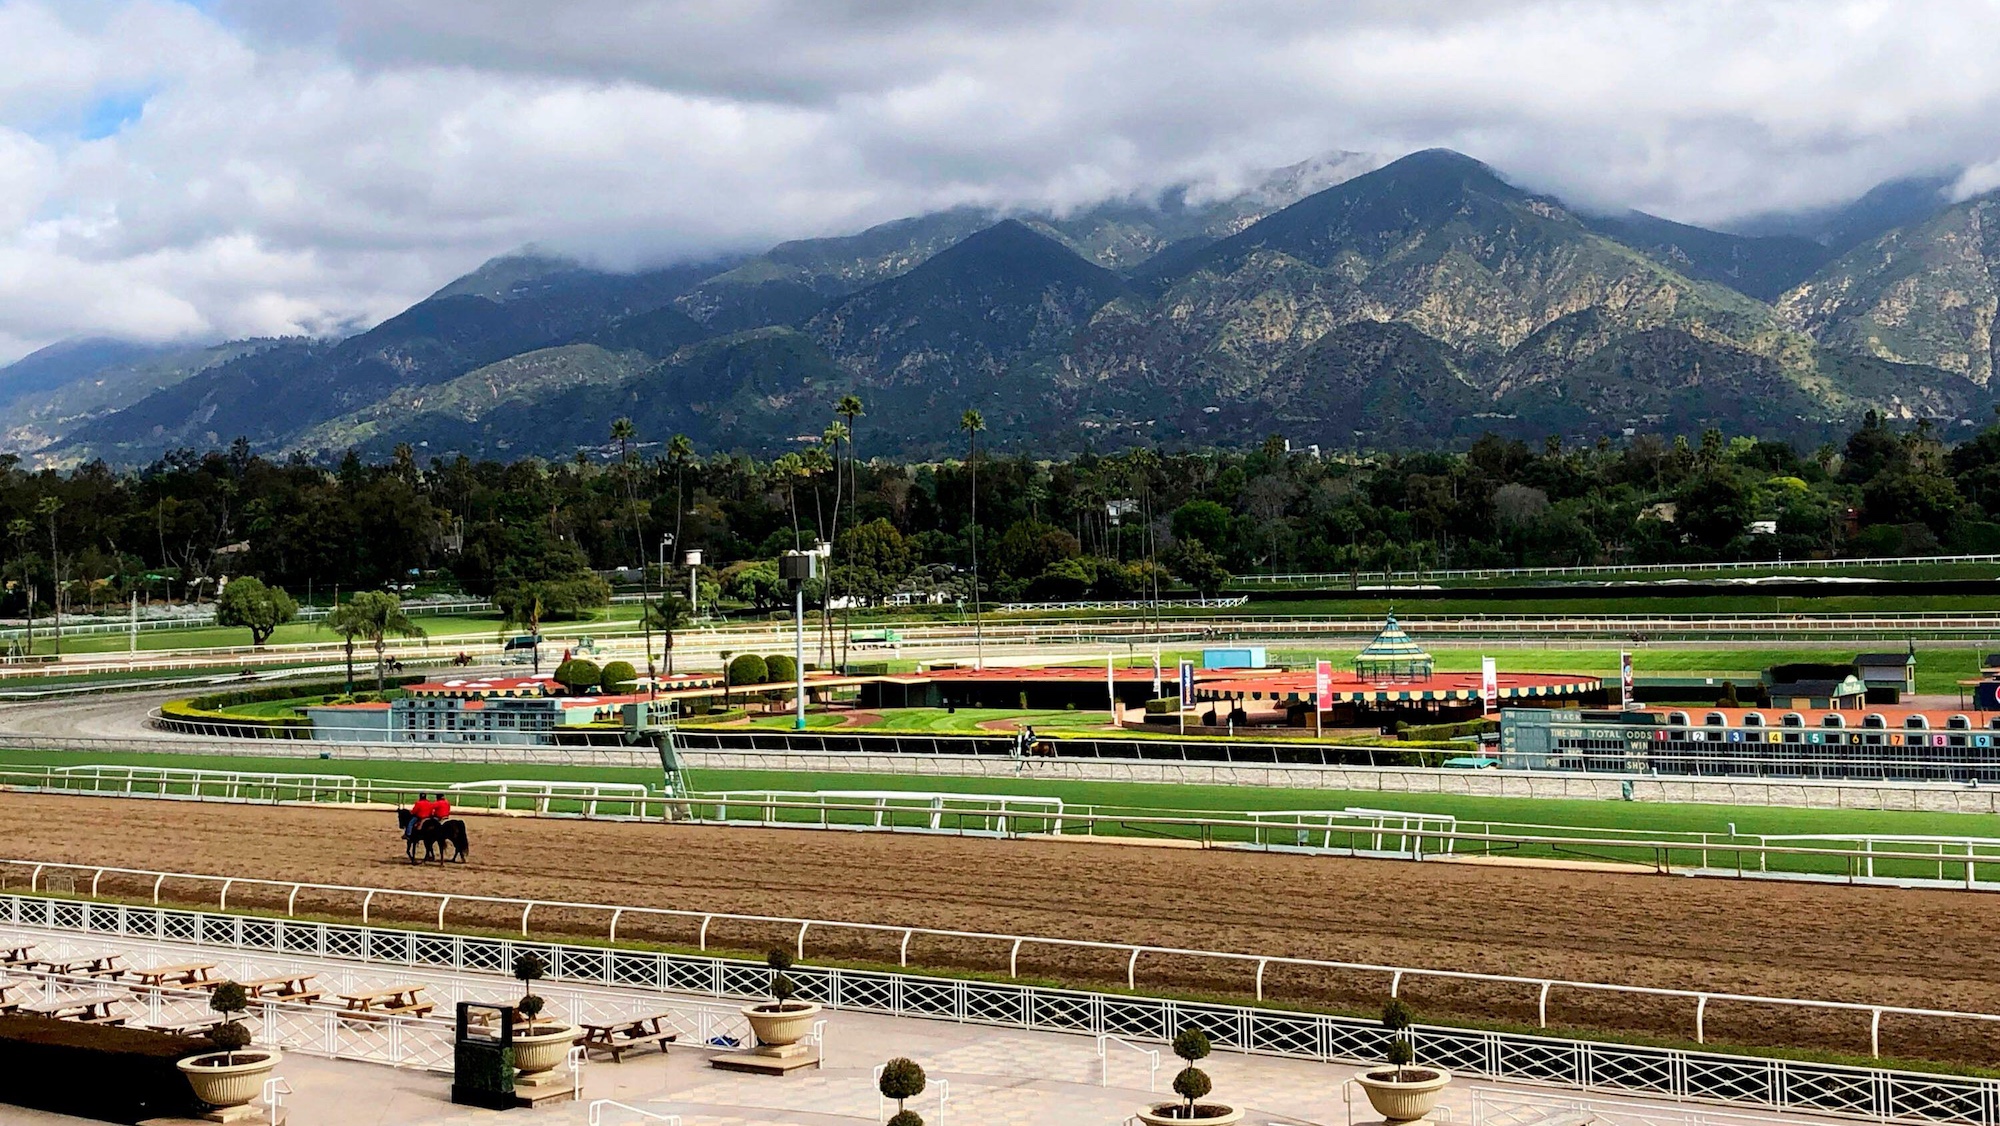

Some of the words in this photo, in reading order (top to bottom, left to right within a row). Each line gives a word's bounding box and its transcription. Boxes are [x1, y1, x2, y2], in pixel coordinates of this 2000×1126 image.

[1551, 713, 1581, 721] TRACK
[1590, 729, 1620, 738] TOTAL
[1626, 731, 1652, 740] ODDS
[1630, 741, 1648, 750] WIN
